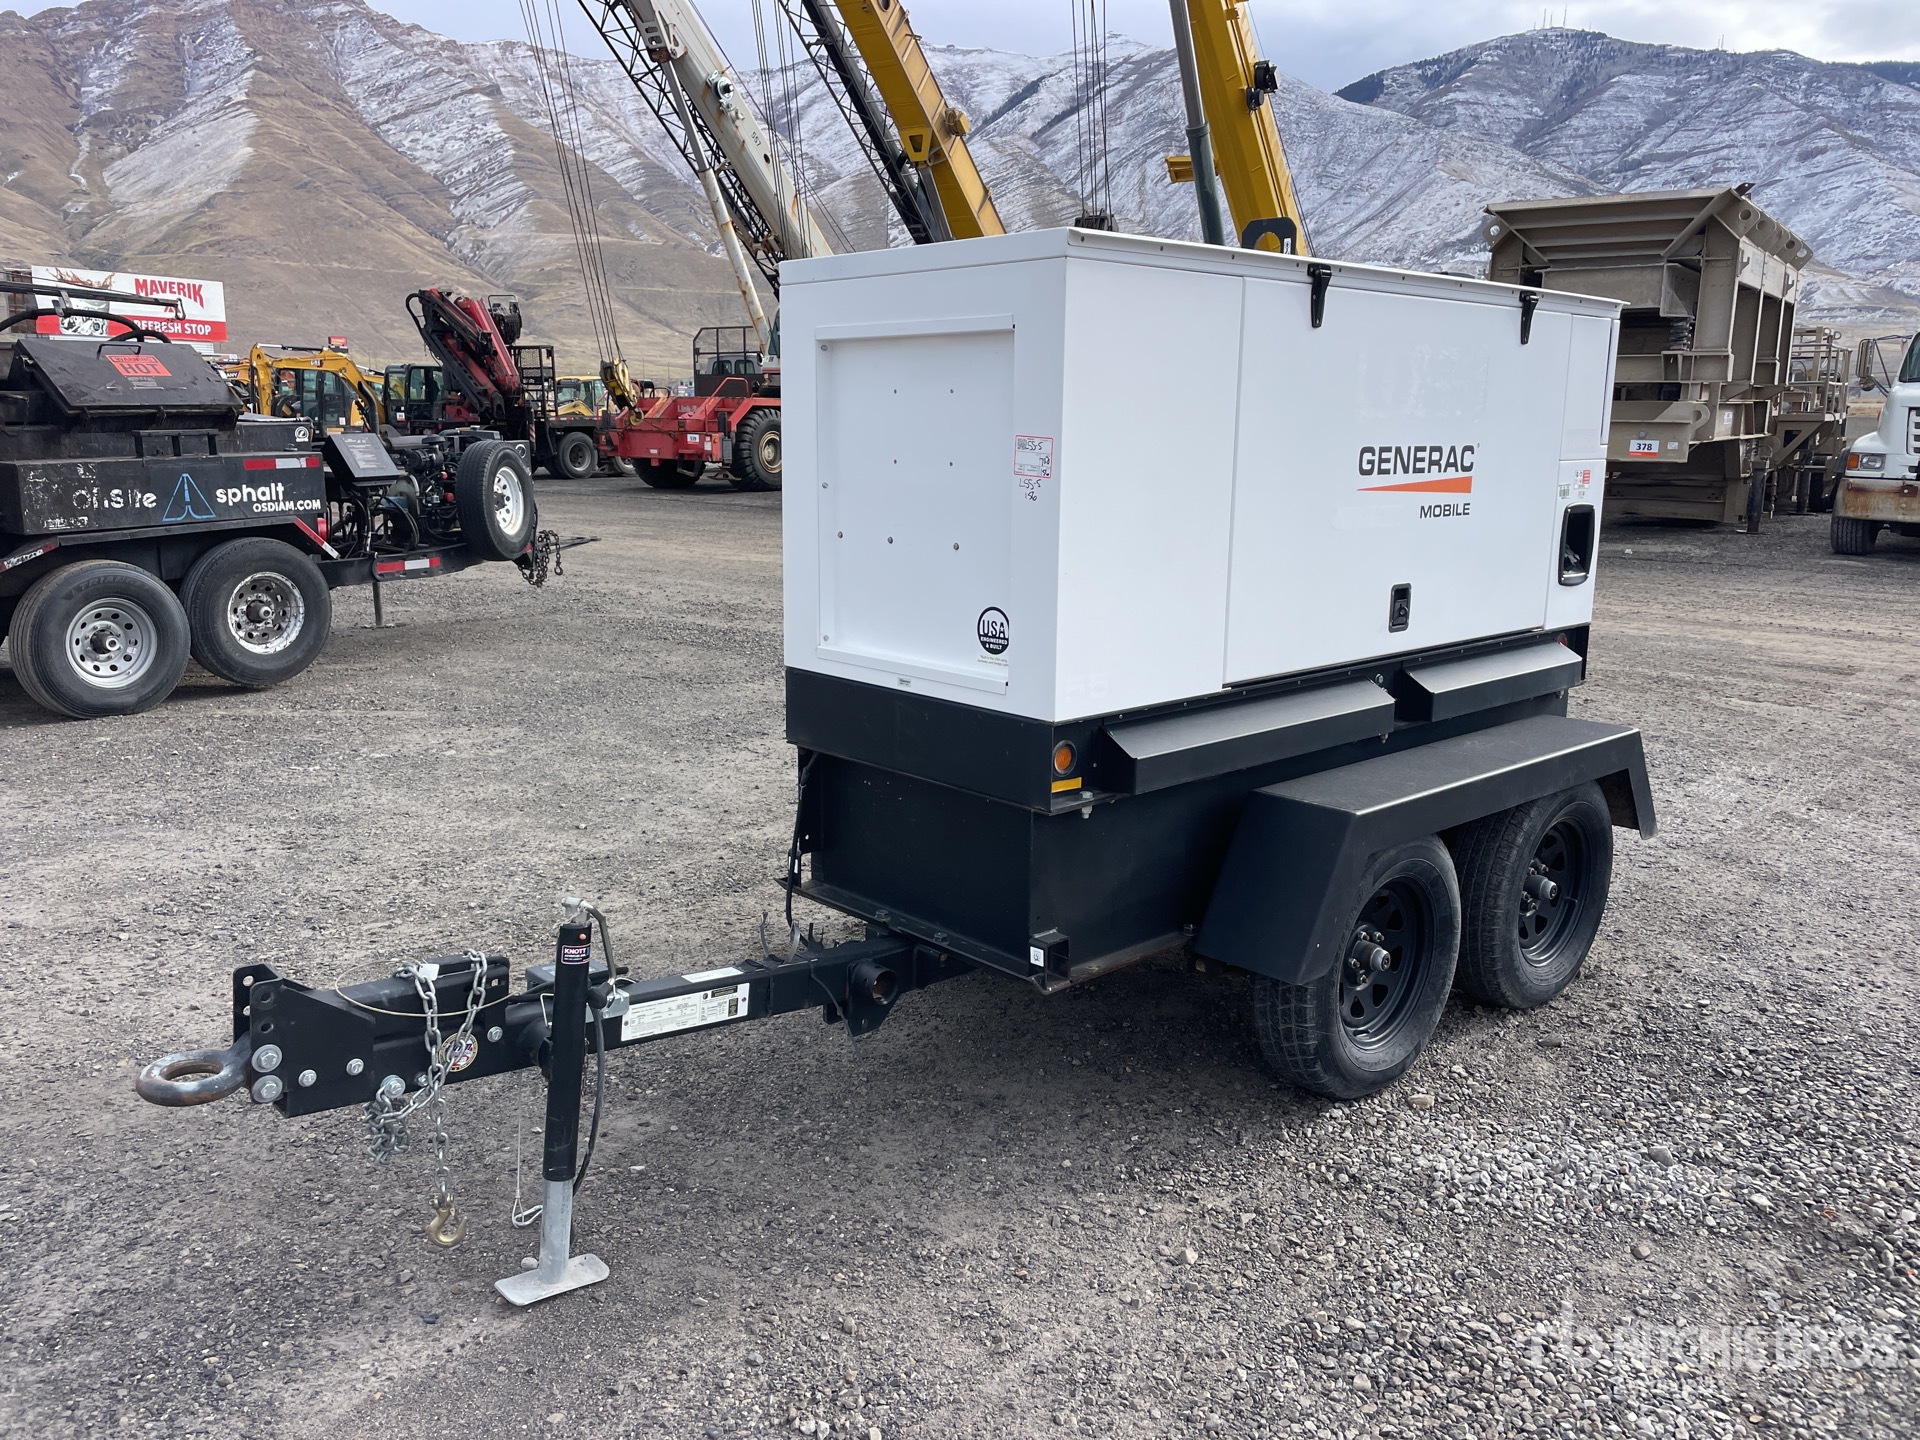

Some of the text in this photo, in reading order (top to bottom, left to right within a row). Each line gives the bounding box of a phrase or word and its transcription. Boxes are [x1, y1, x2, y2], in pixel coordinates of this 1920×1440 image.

[134, 277, 205, 309] MAVERIK
[184, 323, 212, 336] STOP
[119, 363, 162, 374] HOT
[1636, 443, 1652, 451] 378
[1358, 444, 1475, 476] GENERAC
[252, 499, 322, 513] OSDIAM.COM
[1419, 502, 1471, 519] MOBILE
[982, 619, 1006, 638] USA
[564, 947, 587, 955] KNOTT
